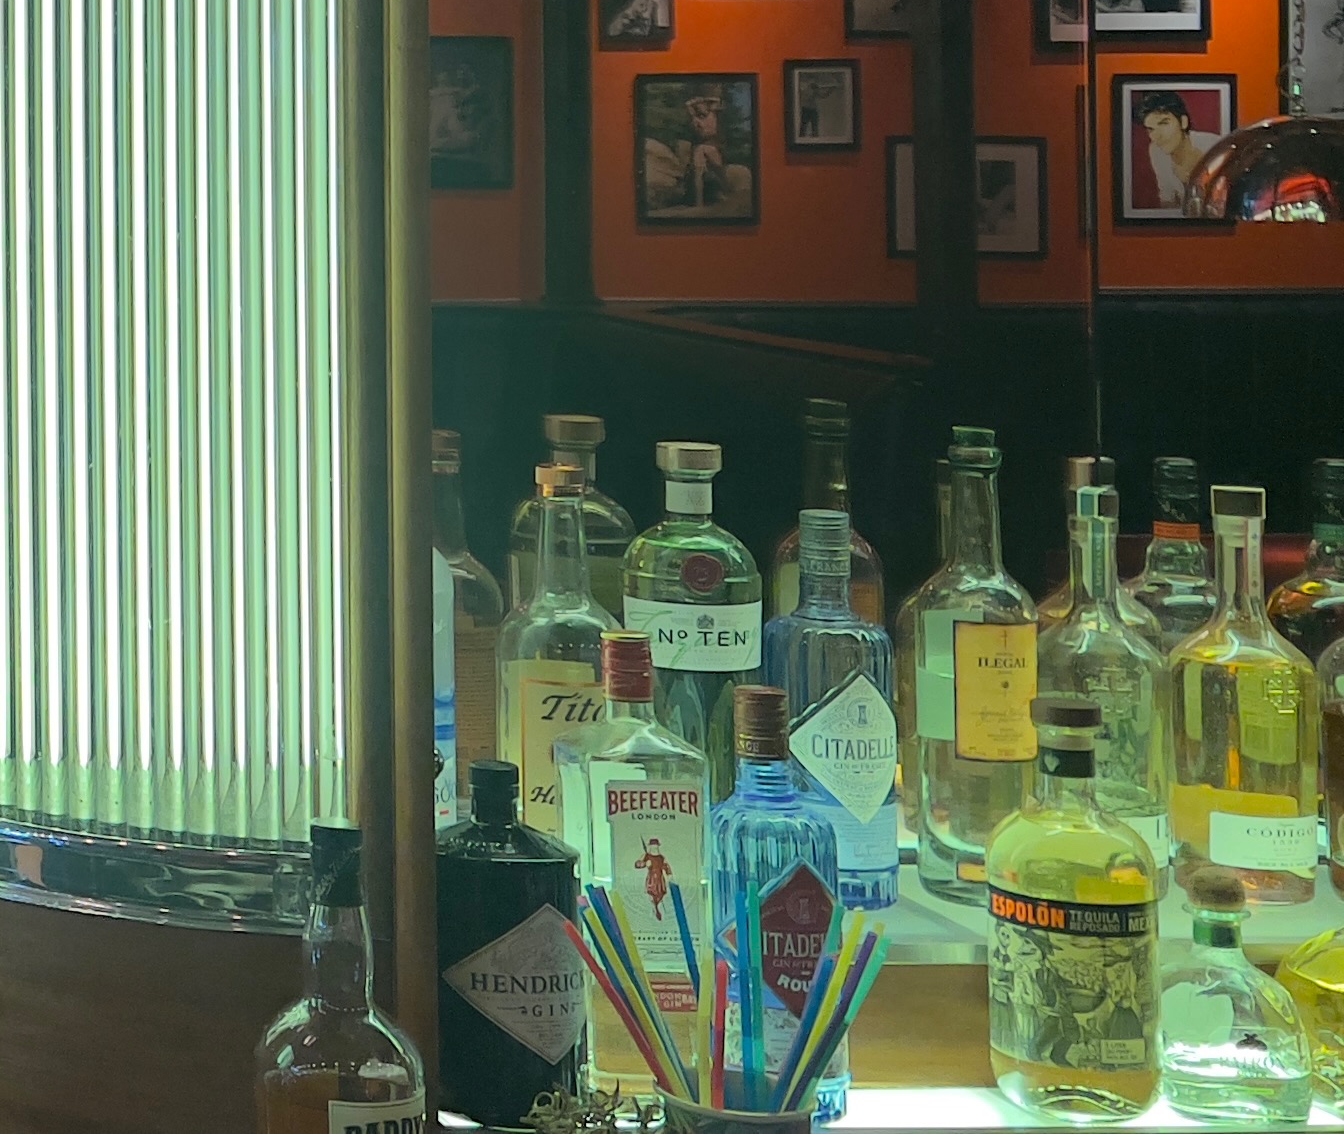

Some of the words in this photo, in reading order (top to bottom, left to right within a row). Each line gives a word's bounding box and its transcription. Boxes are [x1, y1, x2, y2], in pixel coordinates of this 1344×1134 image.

[697, 630, 747, 647] TEN
[978, 656, 1026, 669] ILEGAL
[812, 733, 895, 761] CITADELLE
[607, 790, 699, 817] BEEFEATER
[632, 813, 676, 821] LONDON
[991, 894, 1066, 929] ESPOLÓN
[1069, 909, 1120, 923] TEQUILA
[762, 931, 825, 958] ITADE
[470, 969, 585, 994] HENDRICK
[777, 973, 813, 992] ROU
[532, 1003, 569, 1017] GIN
